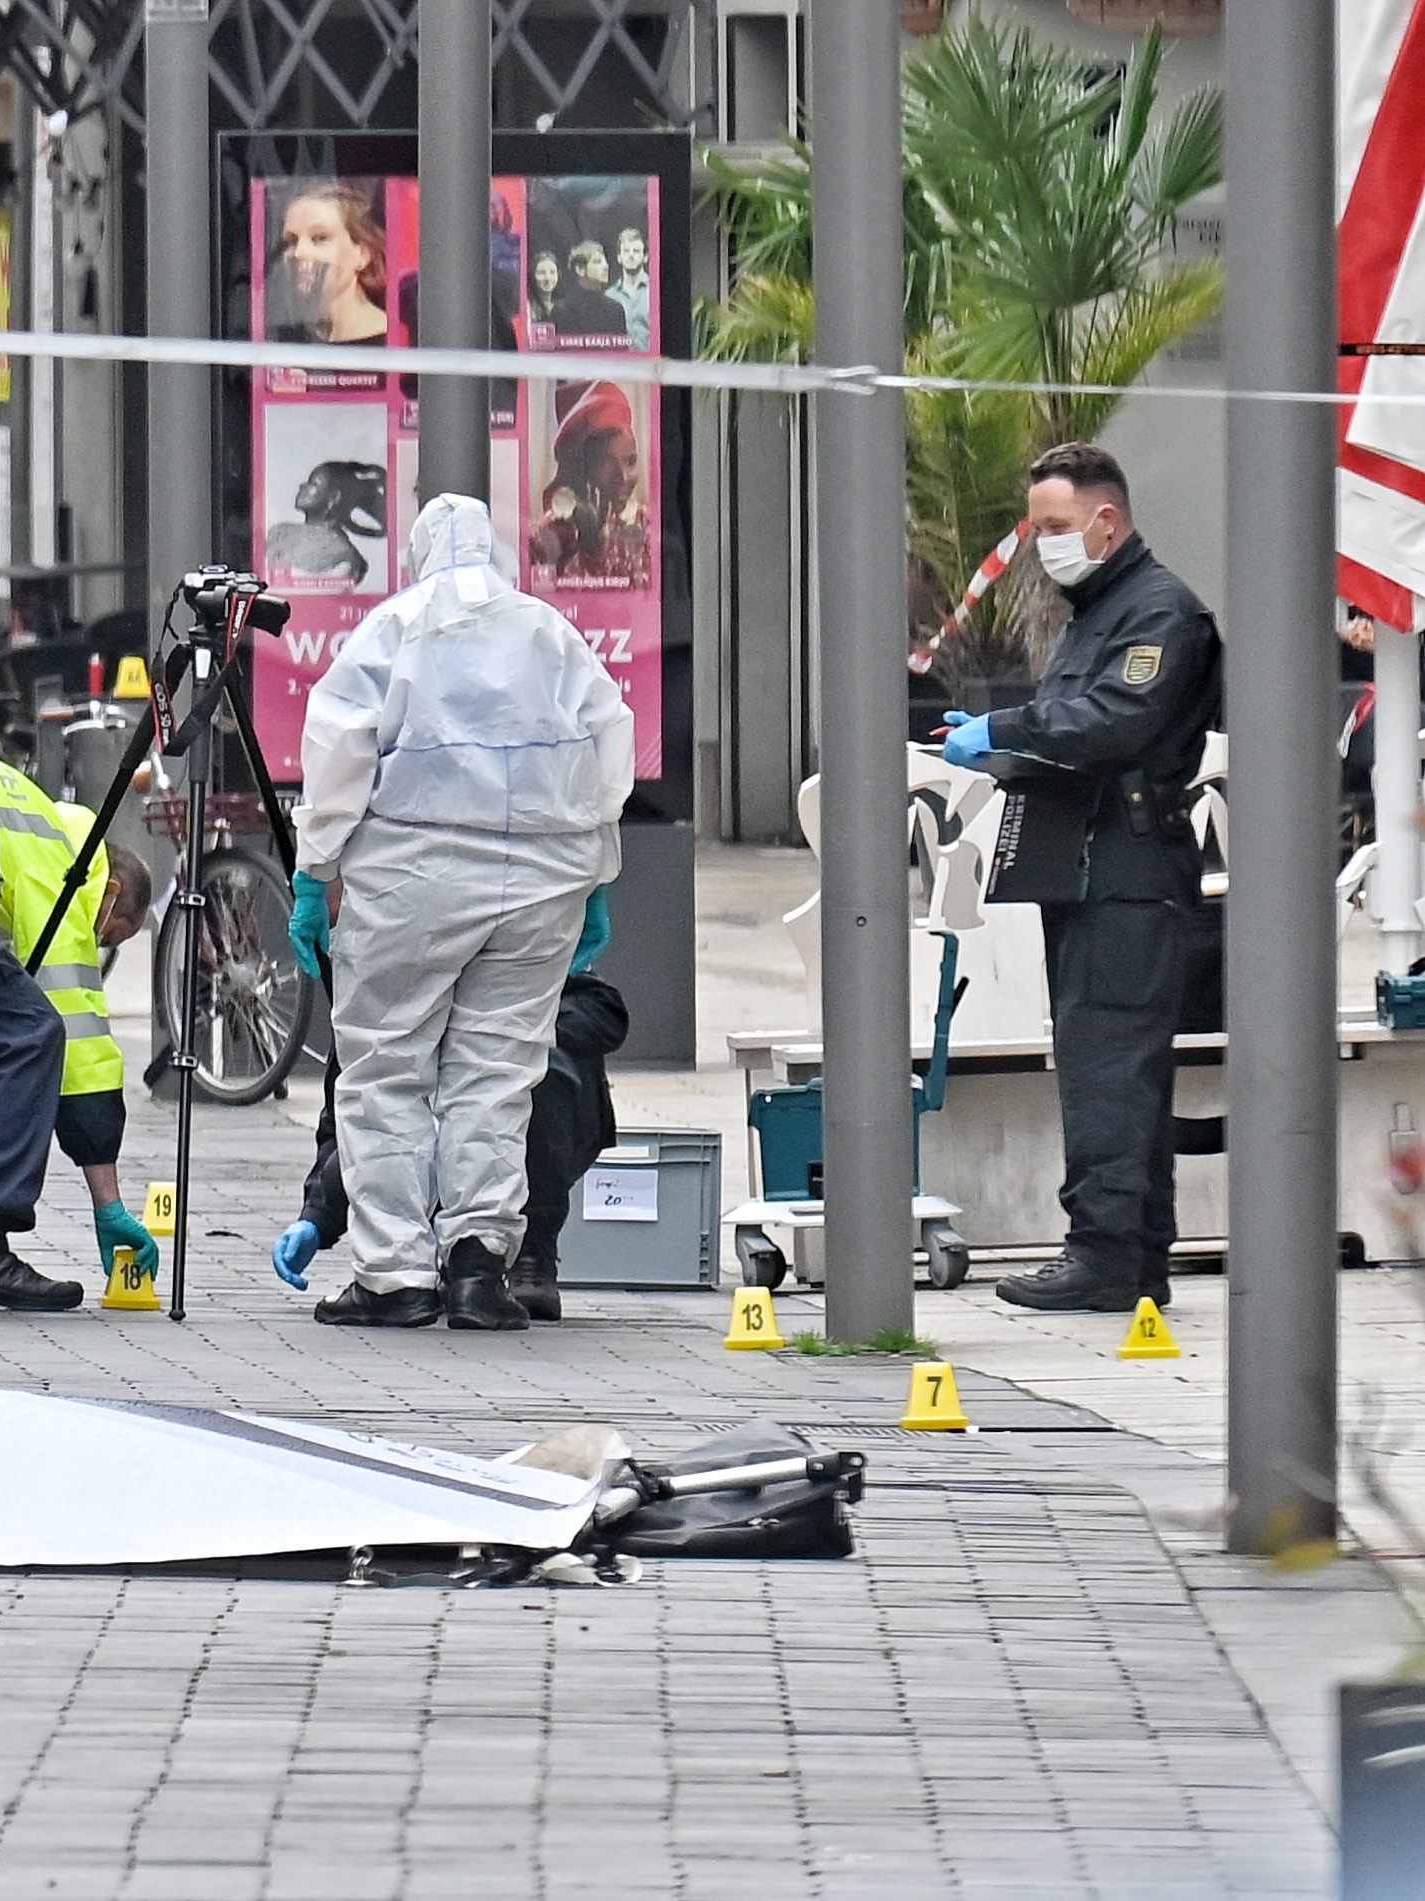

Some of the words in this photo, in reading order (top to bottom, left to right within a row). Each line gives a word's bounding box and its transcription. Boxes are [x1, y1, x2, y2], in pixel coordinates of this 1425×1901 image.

[997, 795, 1017, 853] POLIZEI
[153, 1193, 172, 1217] 19
[120, 1263, 142, 1291] 18
[742, 1303, 764, 1331] 13
[1140, 1317, 1157, 1338] 12
[926, 1376, 943, 1407] 7
